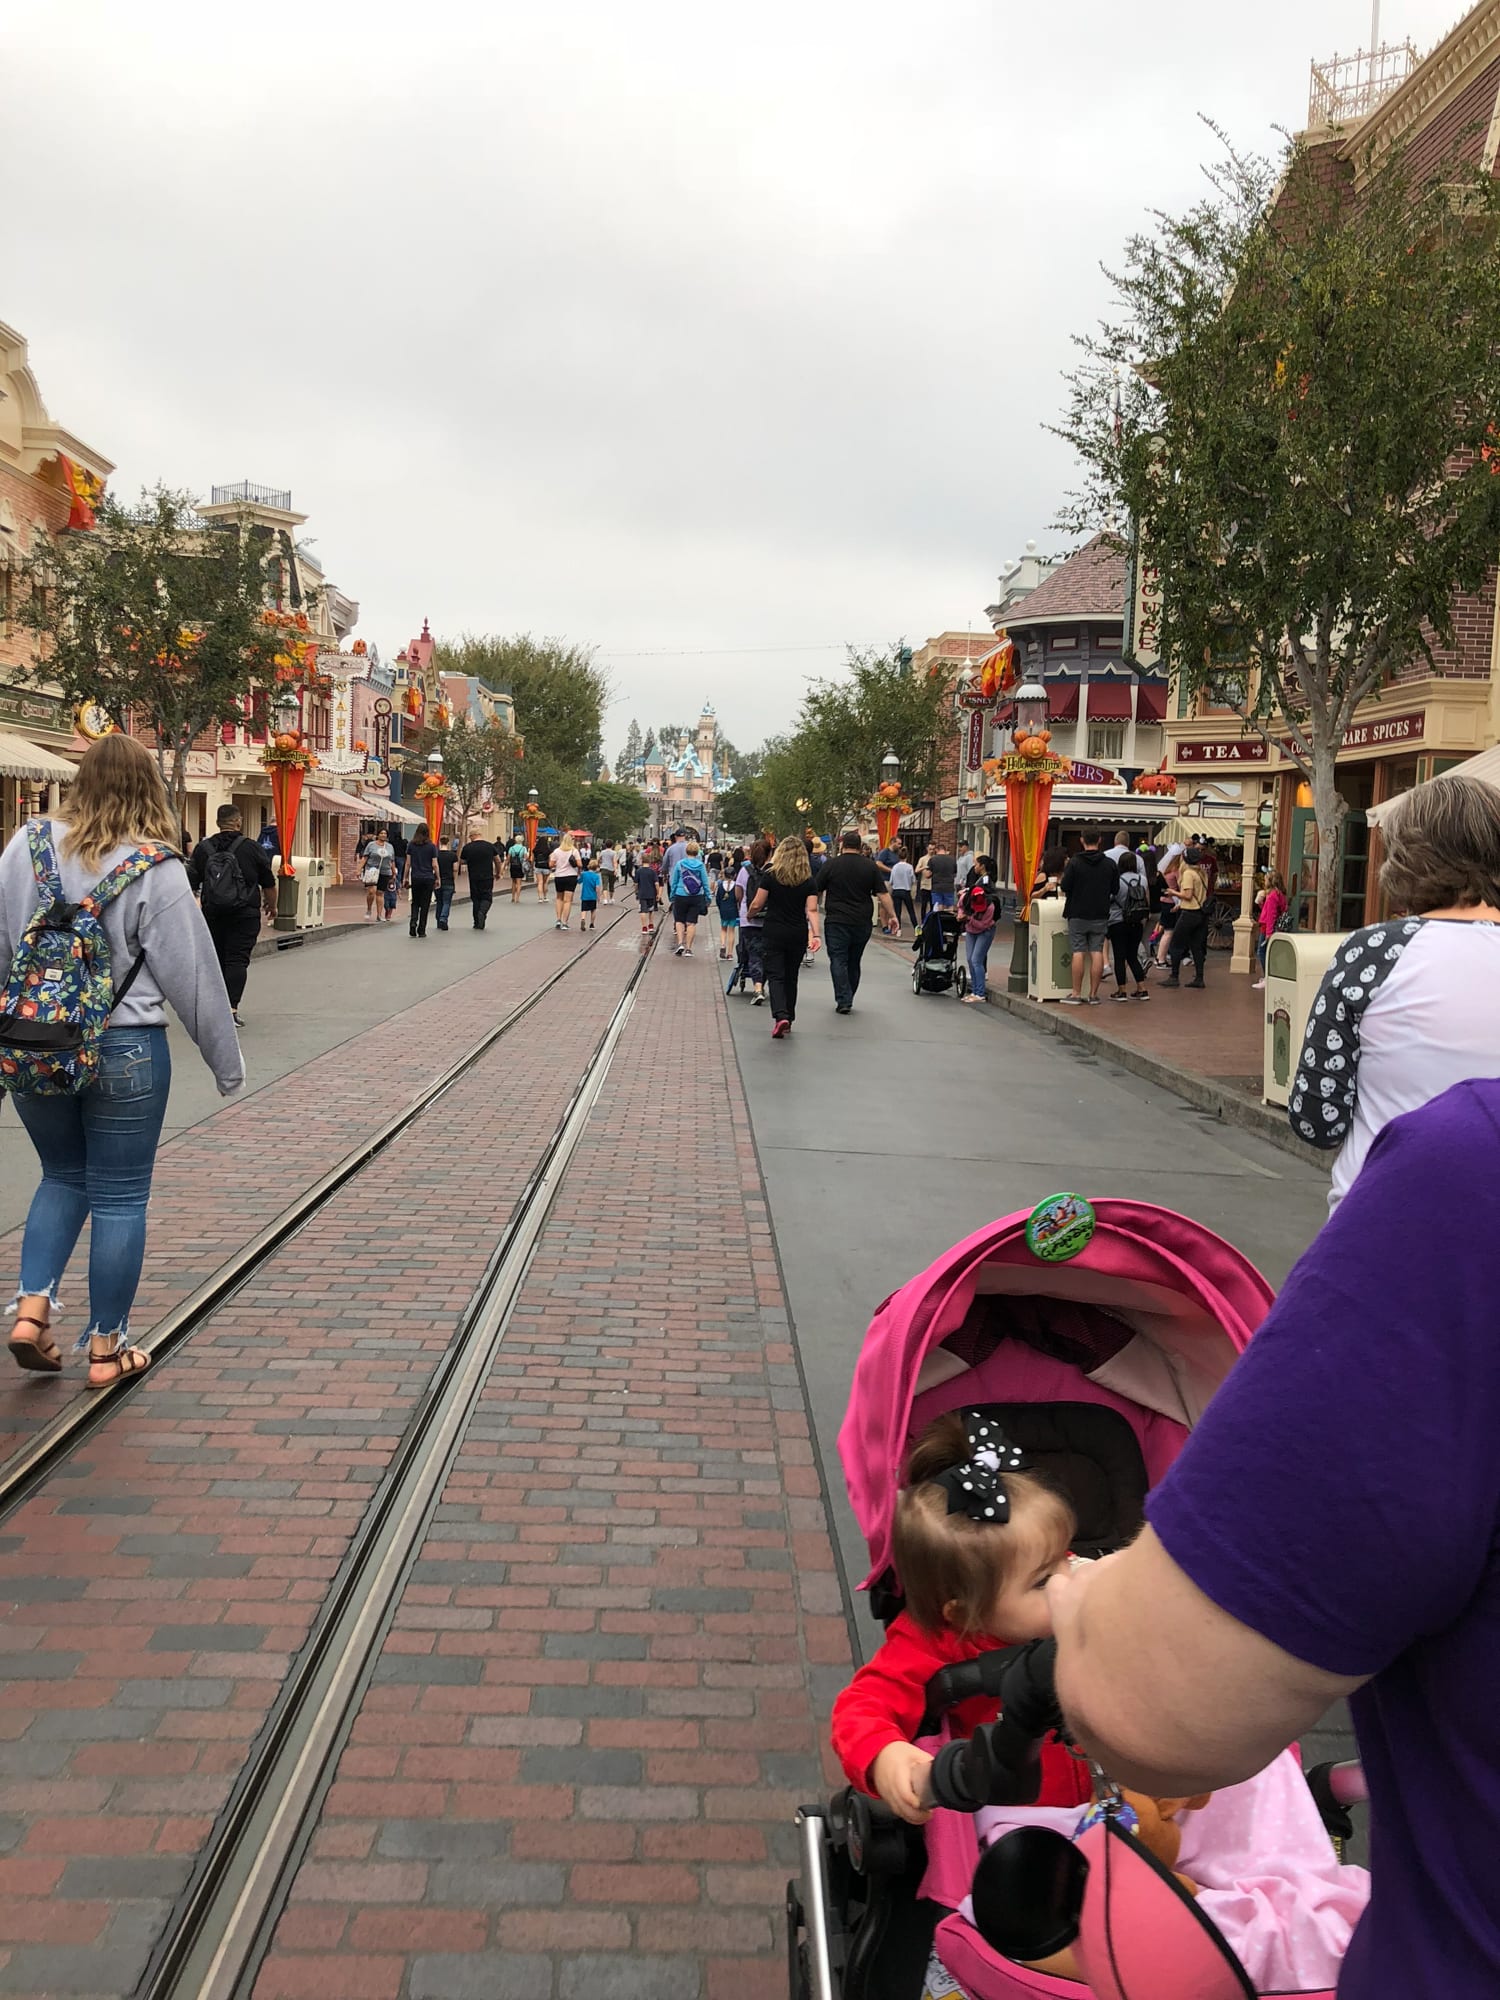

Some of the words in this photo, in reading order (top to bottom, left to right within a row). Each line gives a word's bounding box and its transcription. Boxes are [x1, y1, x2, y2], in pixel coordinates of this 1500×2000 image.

[1138, 566, 1161, 650] HOUSE
[1372, 719, 1410, 740] SPICES
[1202, 745, 1241, 759] TEA
